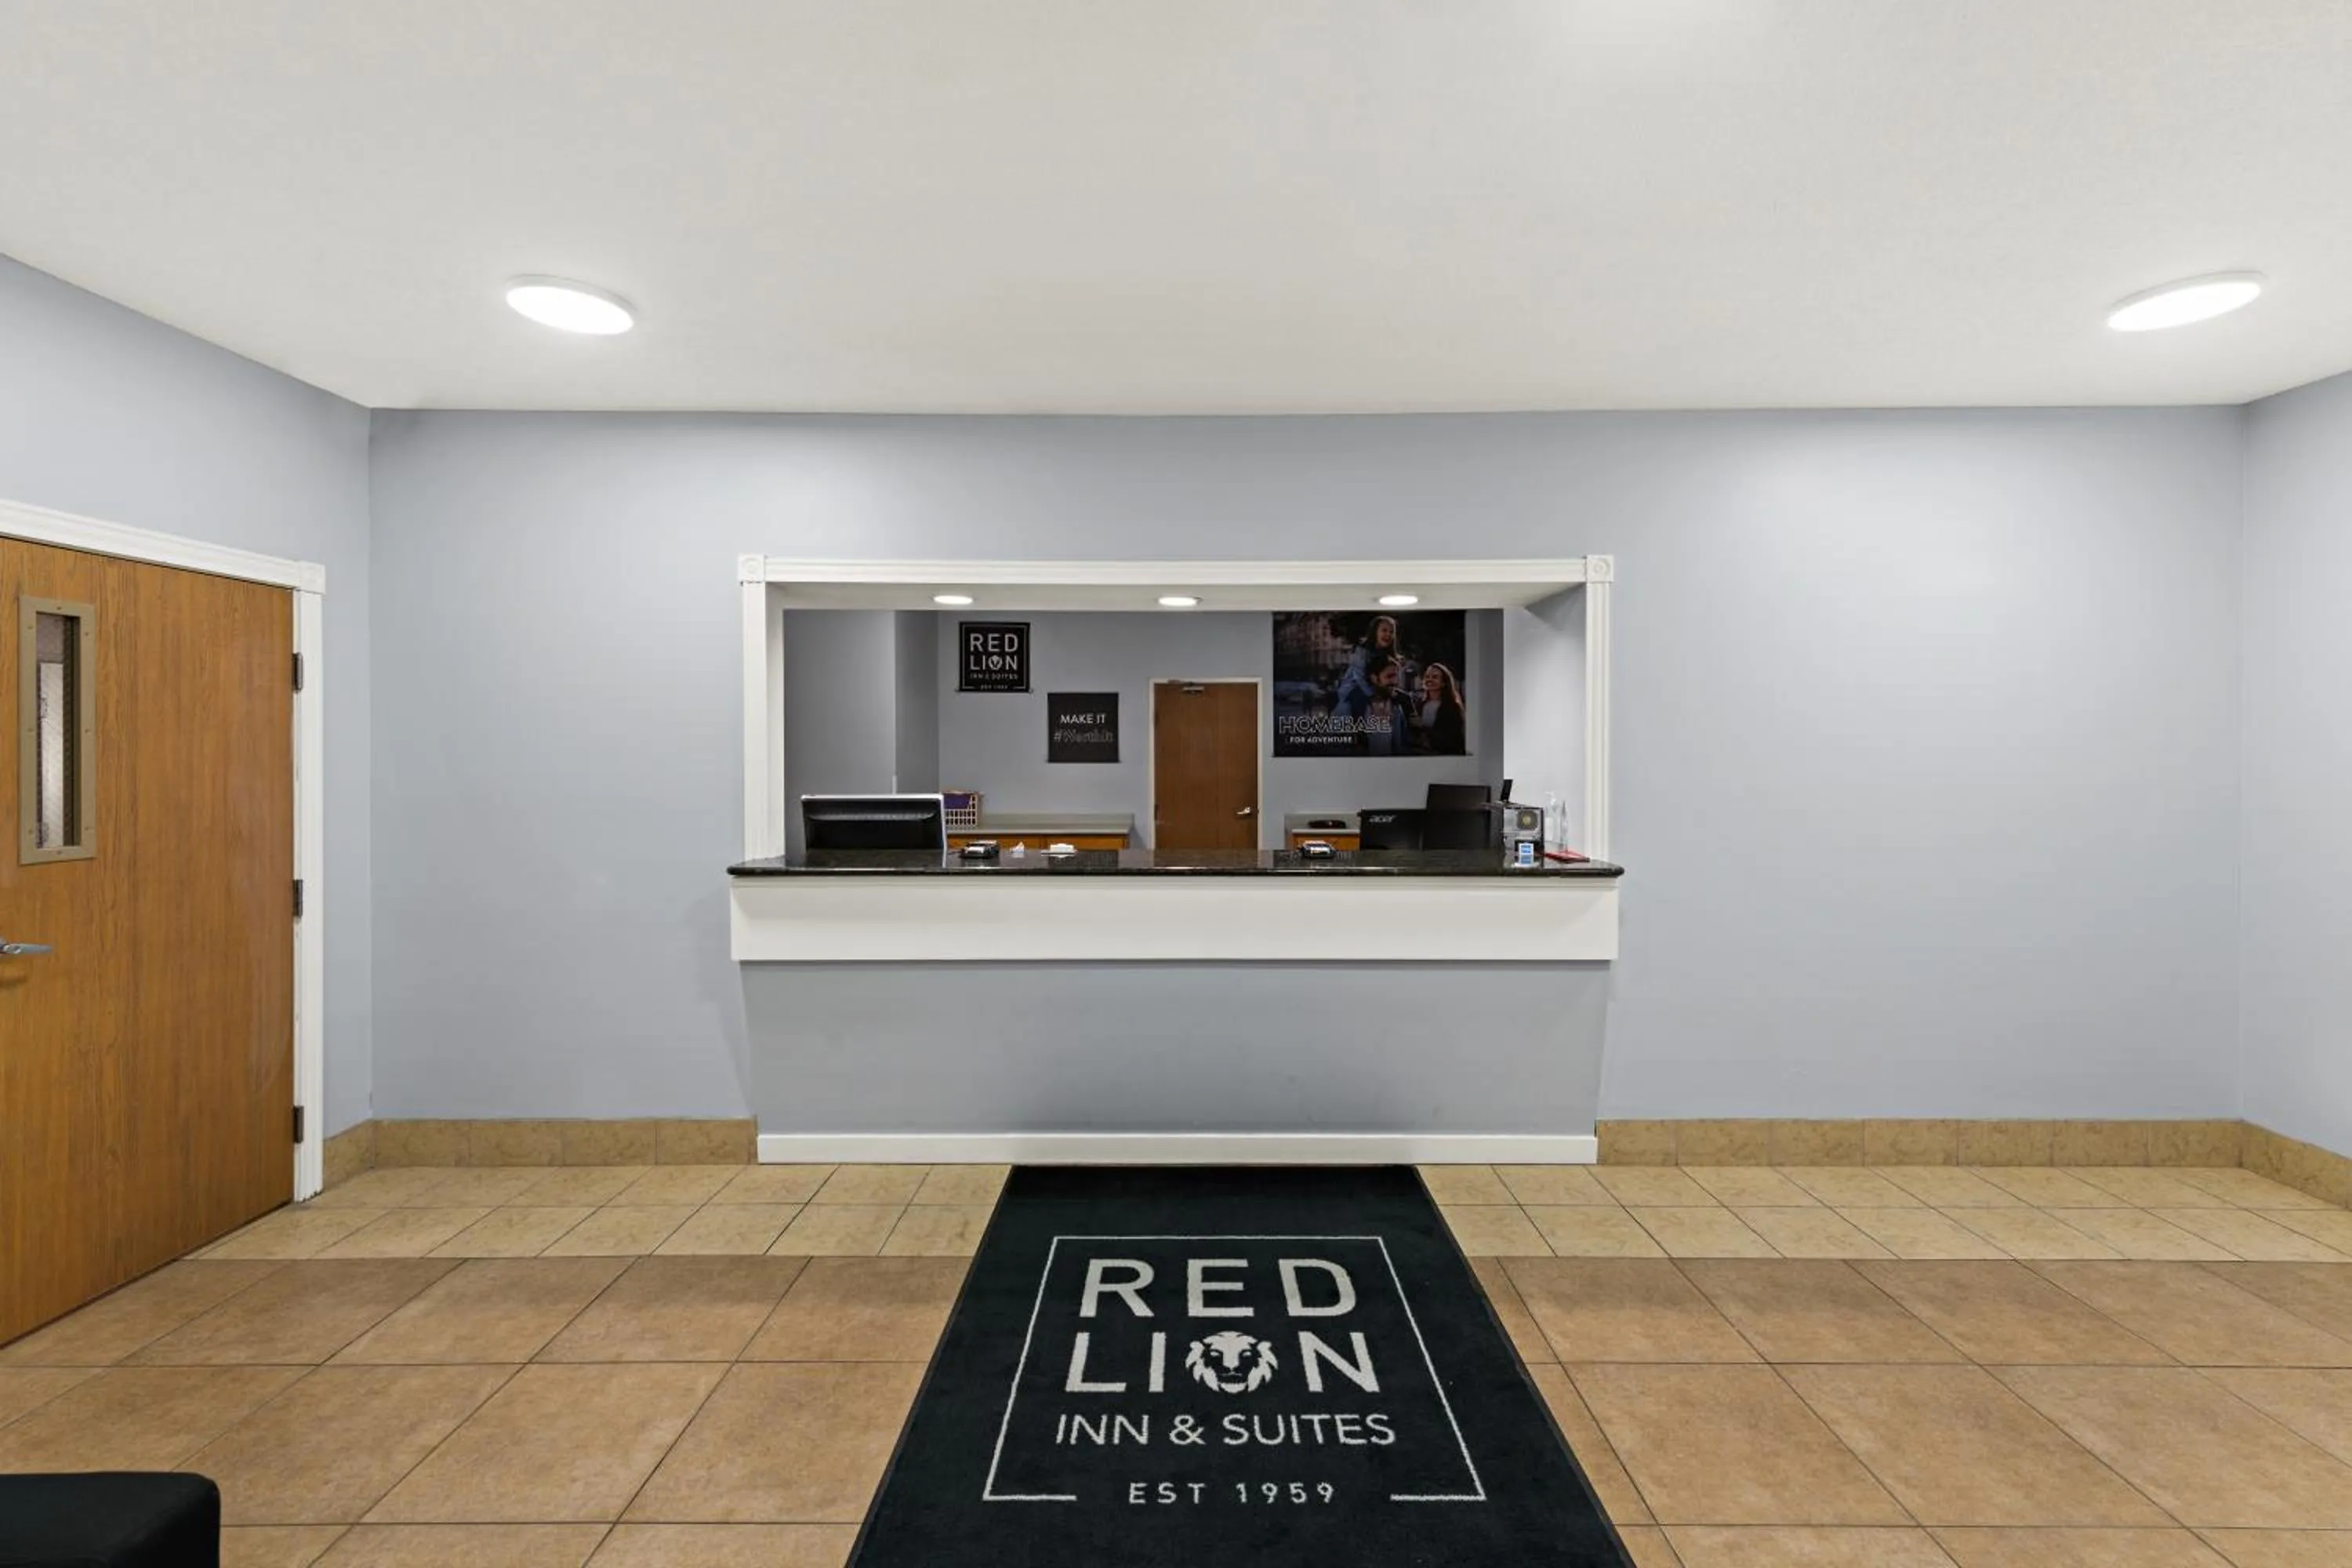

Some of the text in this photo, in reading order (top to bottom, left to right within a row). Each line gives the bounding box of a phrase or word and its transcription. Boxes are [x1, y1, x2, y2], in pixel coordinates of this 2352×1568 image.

[970, 633, 1018, 652] RED
[1061, 714, 1106, 724] MAKE IT
[1279, 714, 1392, 735] HOMEBASE
[1079, 1258, 1357, 1318] RED
[1055, 1414, 1396, 1445] INN & SUITES
[1128, 1483, 1335, 1504] EST 1959
